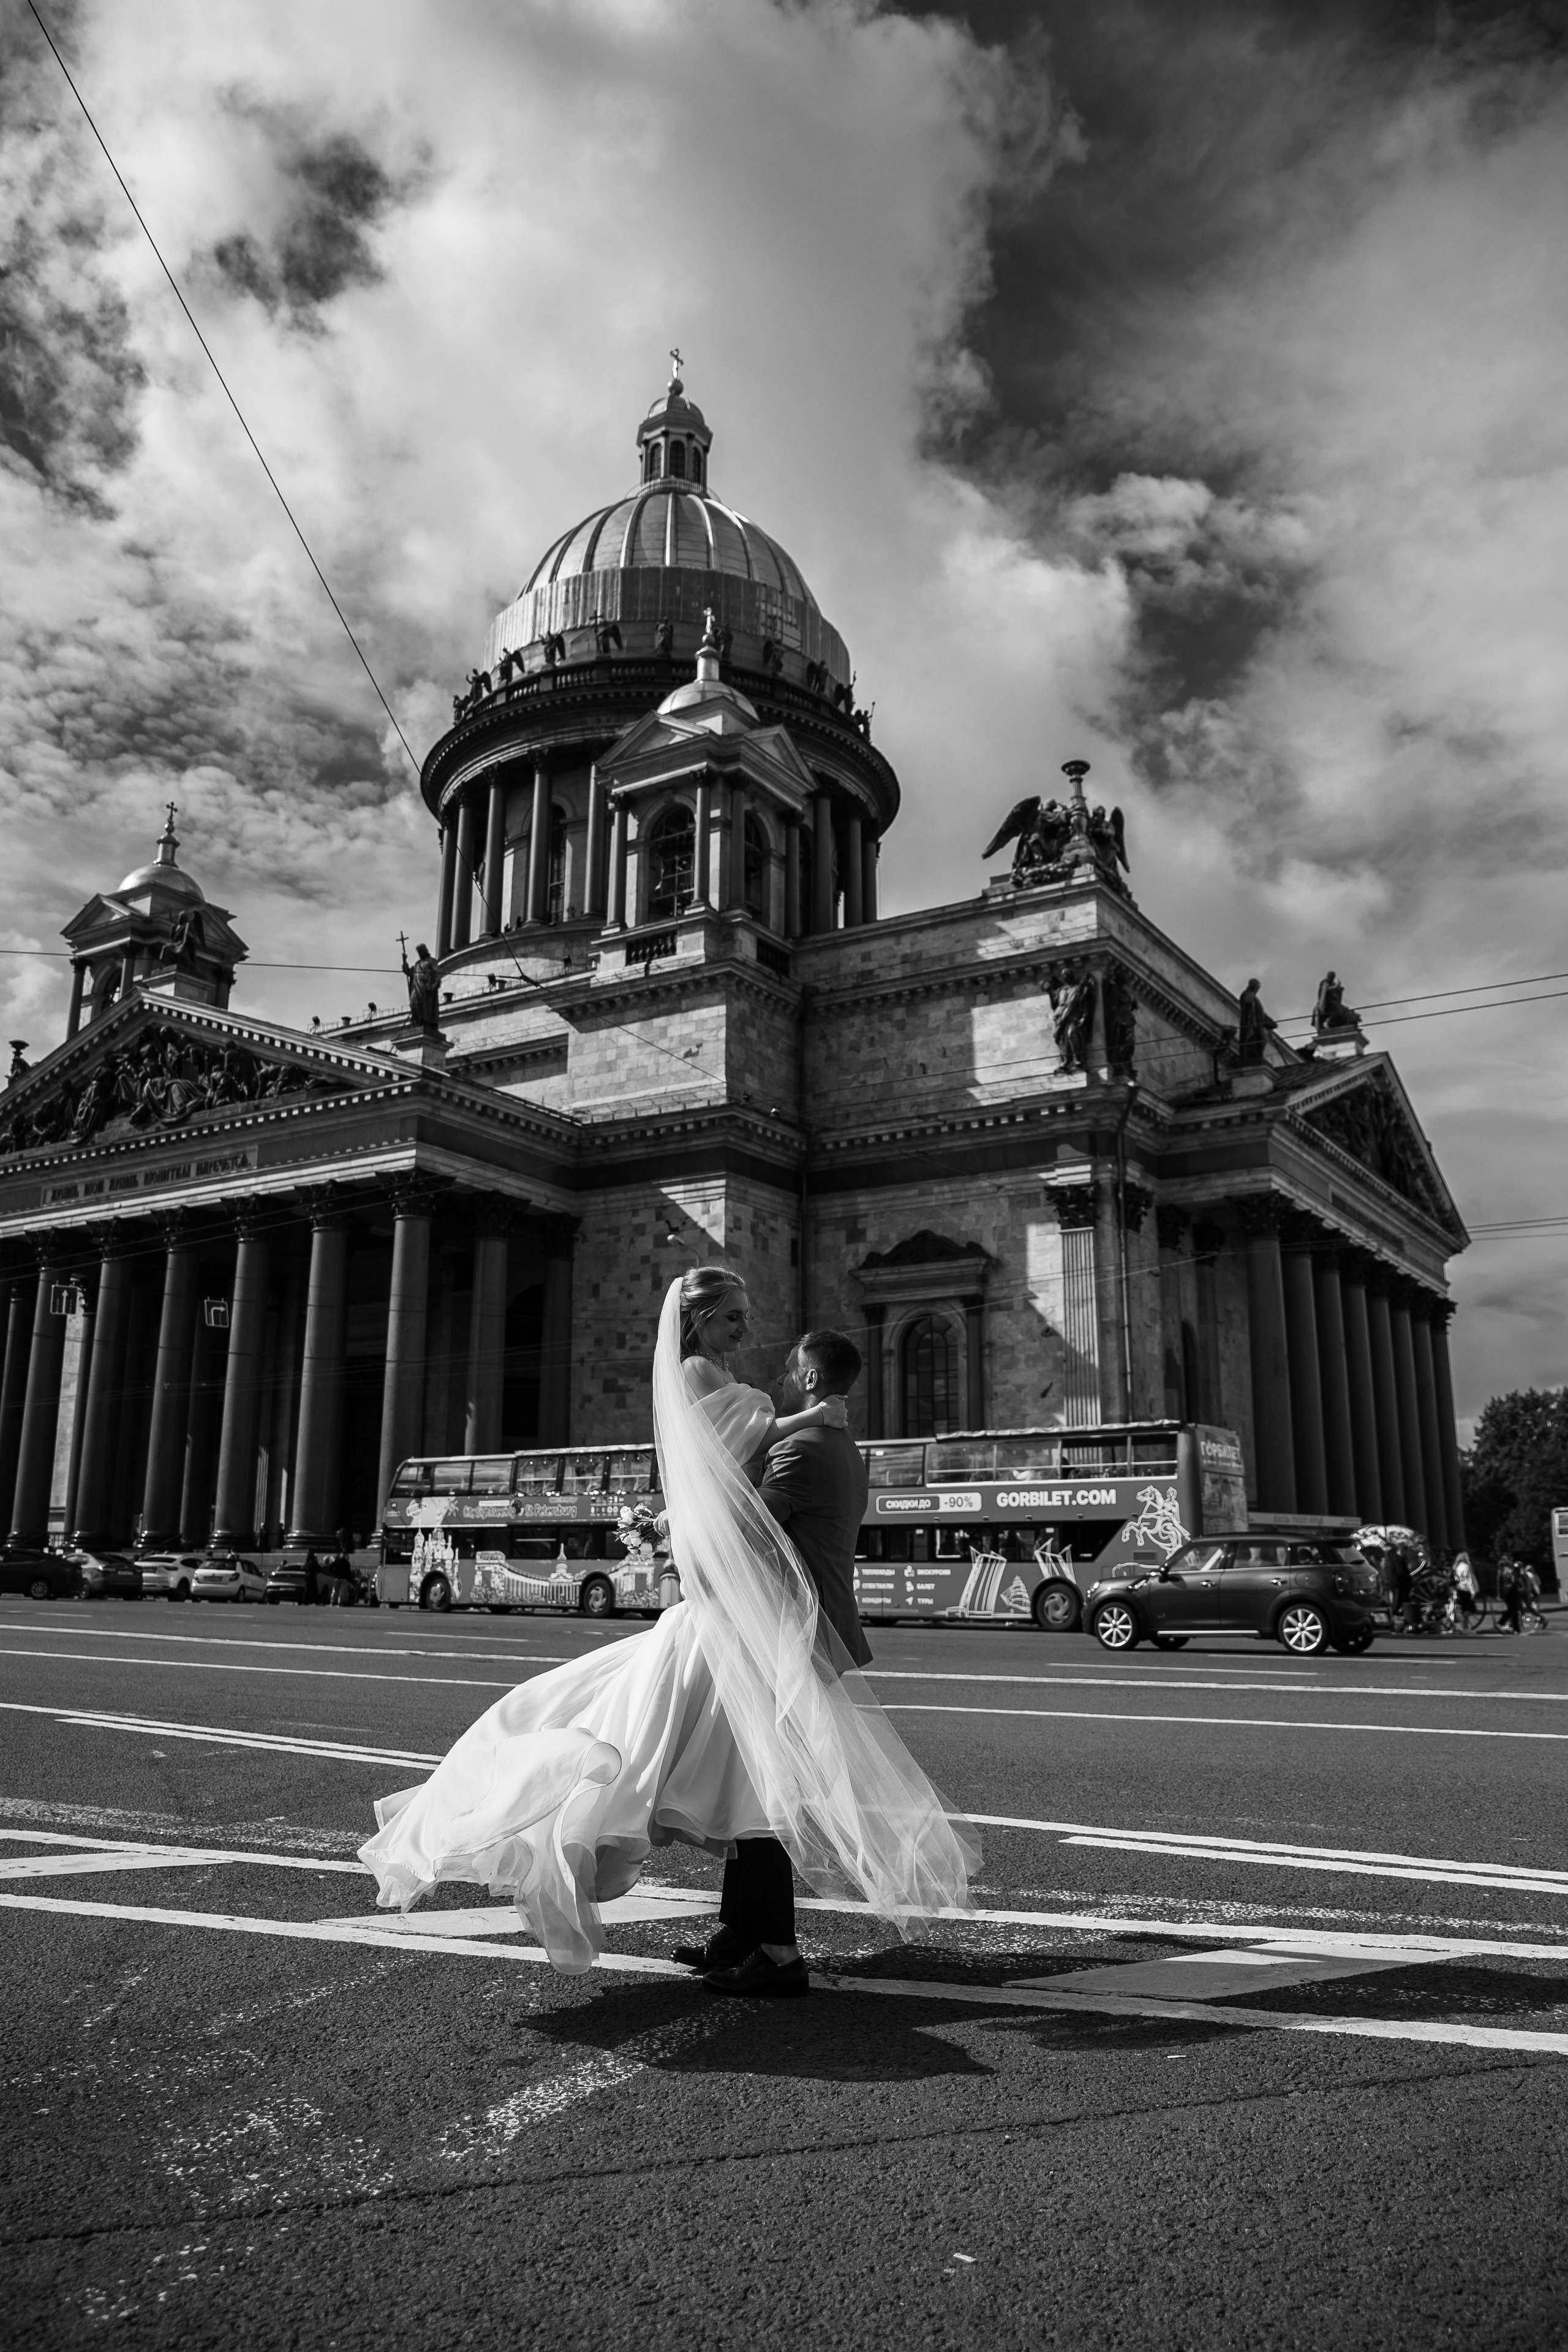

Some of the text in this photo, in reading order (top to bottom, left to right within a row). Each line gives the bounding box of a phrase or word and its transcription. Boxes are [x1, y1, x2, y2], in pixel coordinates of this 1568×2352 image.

[886, 1495, 974, 1510] СКИДКИ ДО -90%
[996, 1489, 1117, 1507] GORBILET.COM
